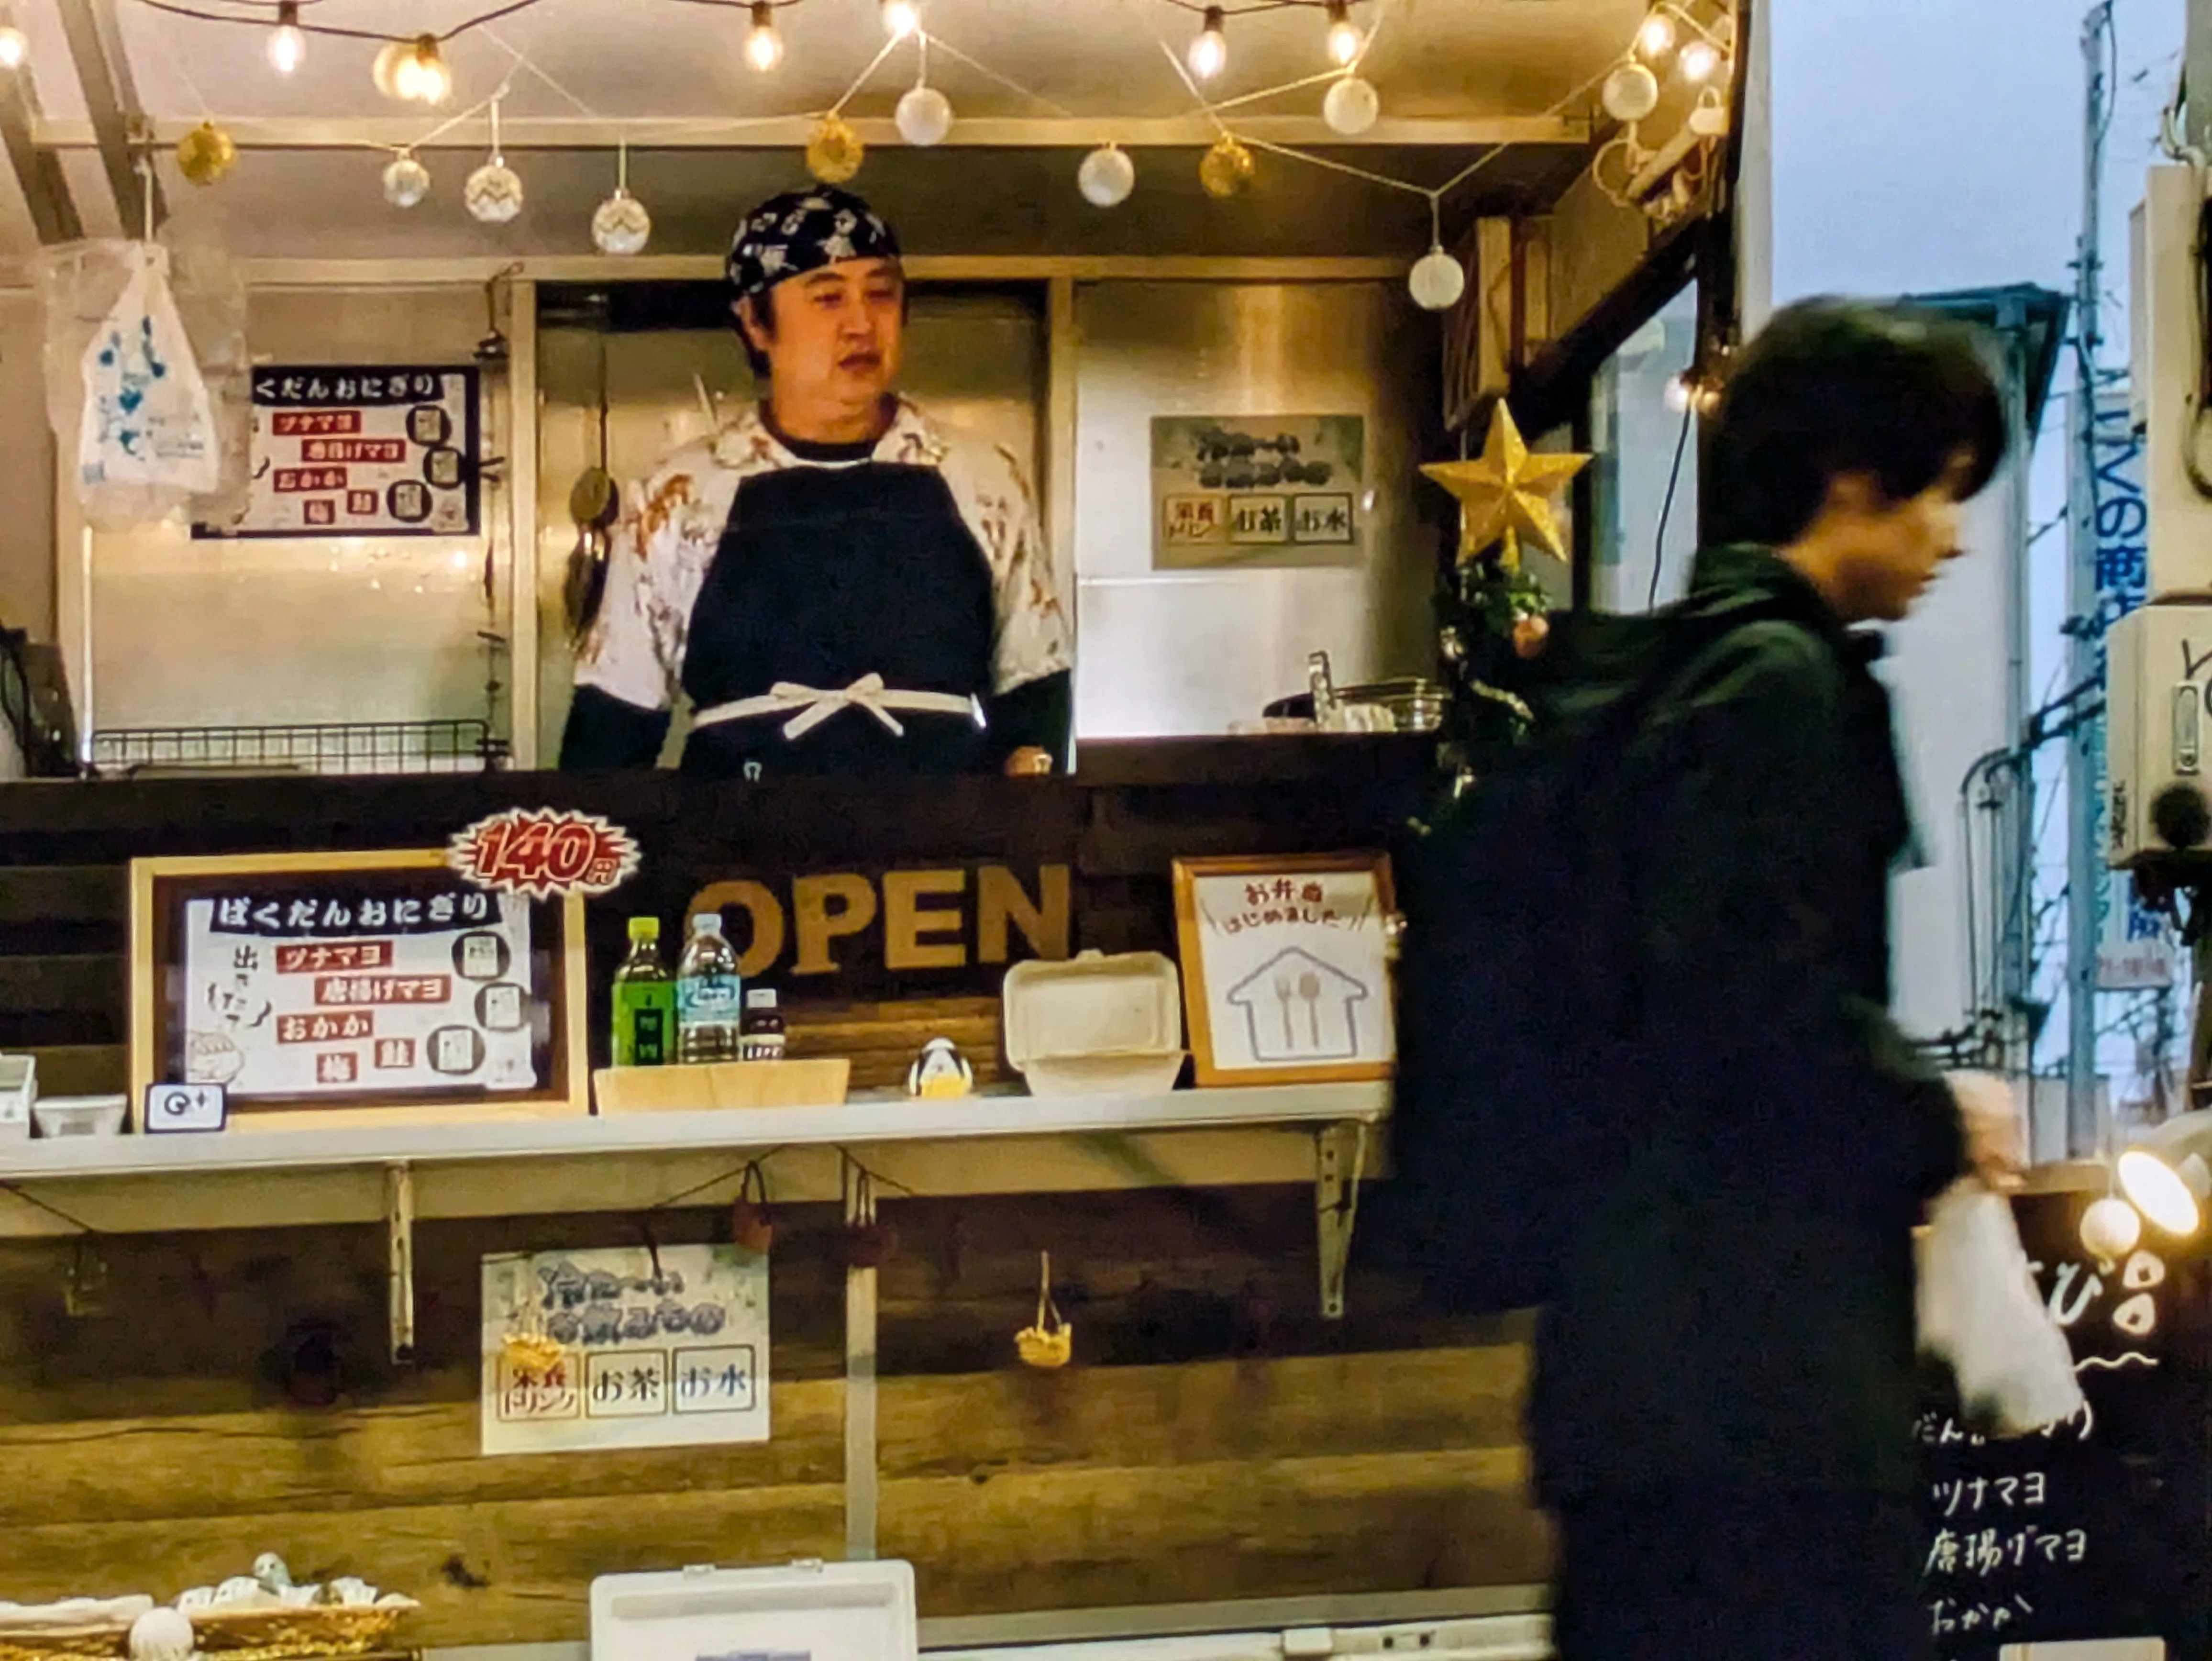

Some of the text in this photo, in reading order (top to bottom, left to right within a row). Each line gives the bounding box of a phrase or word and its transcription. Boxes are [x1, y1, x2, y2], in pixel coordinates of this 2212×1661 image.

[476, 821, 619, 884] 140円
[219, 891, 488, 929] ばくだんおにぎり
[683, 864, 1071, 979] OPEN
[285, 944, 381, 971] ツナマヨ
[282, 1013, 369, 1041] おかか
[592, 1367, 660, 1402] お茶
[680, 1363, 747, 1398] お水
[1932, 1472, 2046, 1517] ツナマヨ
